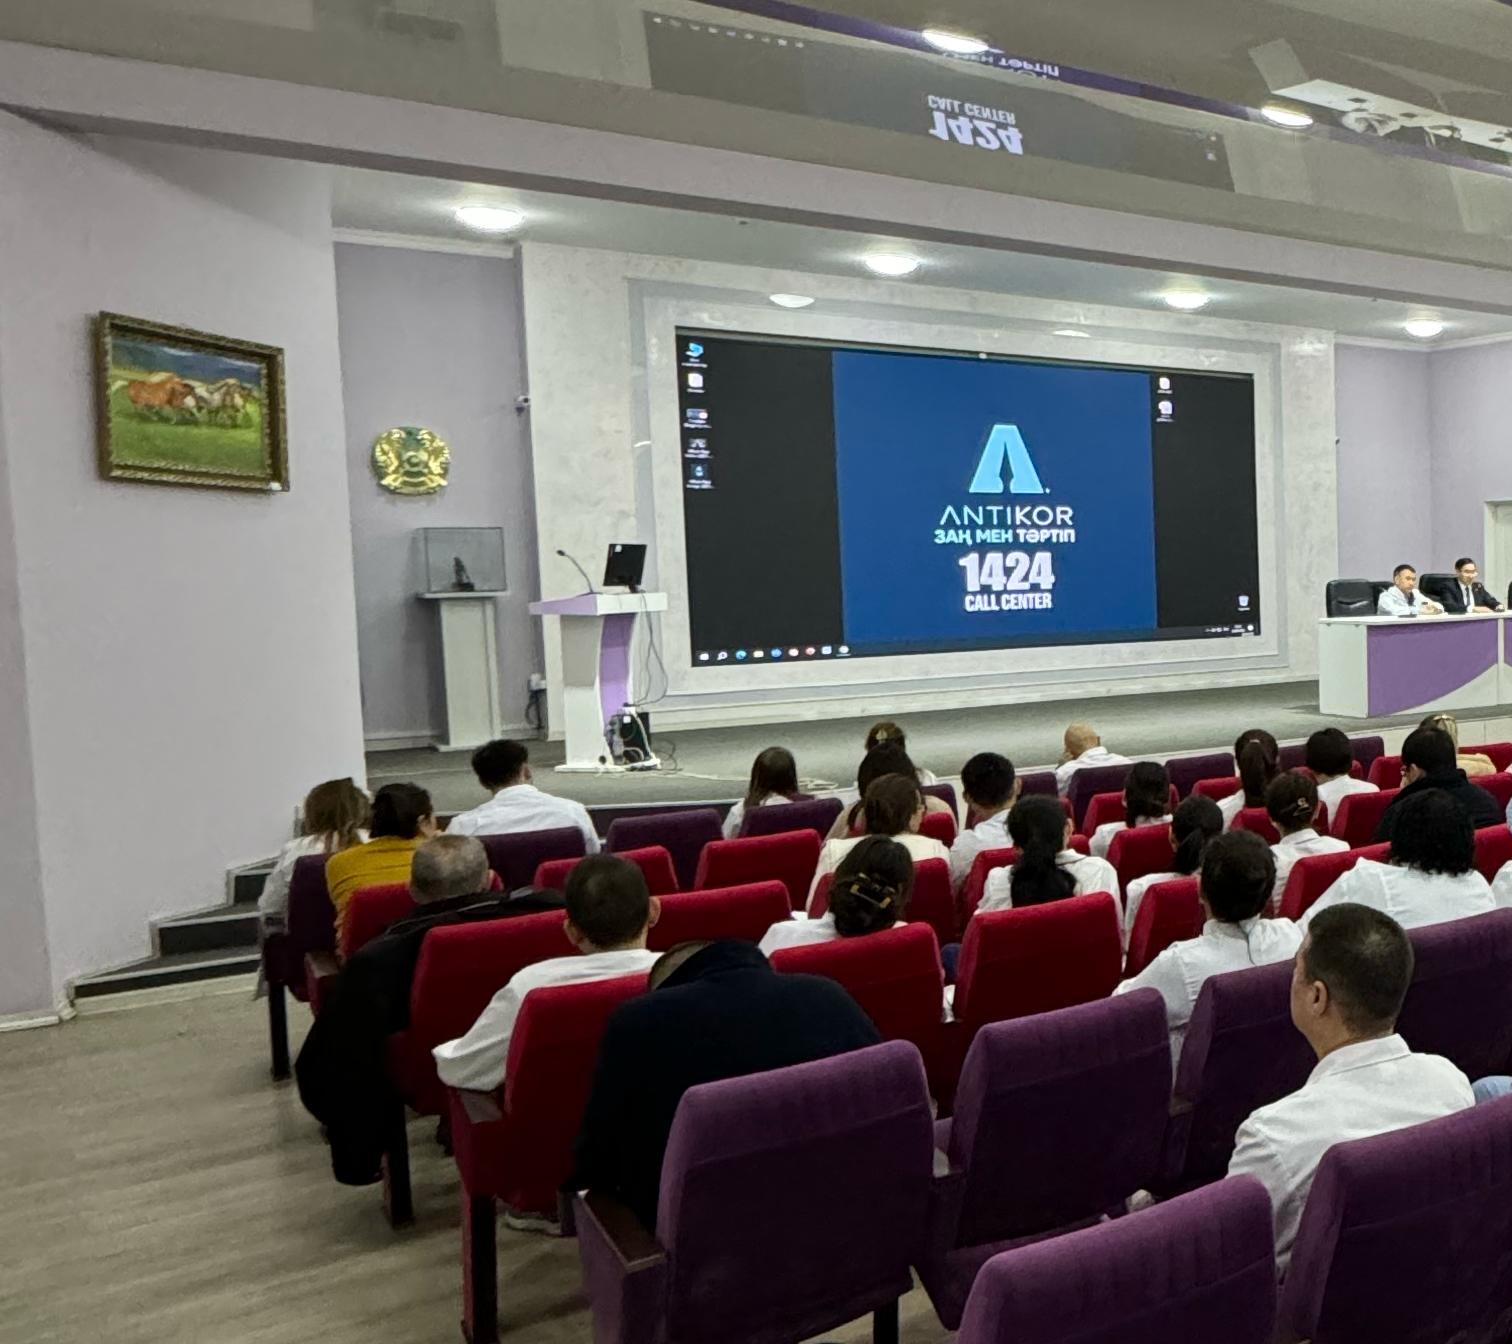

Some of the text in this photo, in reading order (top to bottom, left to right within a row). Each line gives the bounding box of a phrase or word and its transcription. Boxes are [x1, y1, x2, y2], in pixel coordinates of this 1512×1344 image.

[939, 504, 1075, 526] ANTIKOR
[933, 528, 1077, 546] ЗАҢ МЕН ТӘРТІП
[958, 550, 1056, 592] 1424
[964, 592, 1053, 613] CALL CENTER
